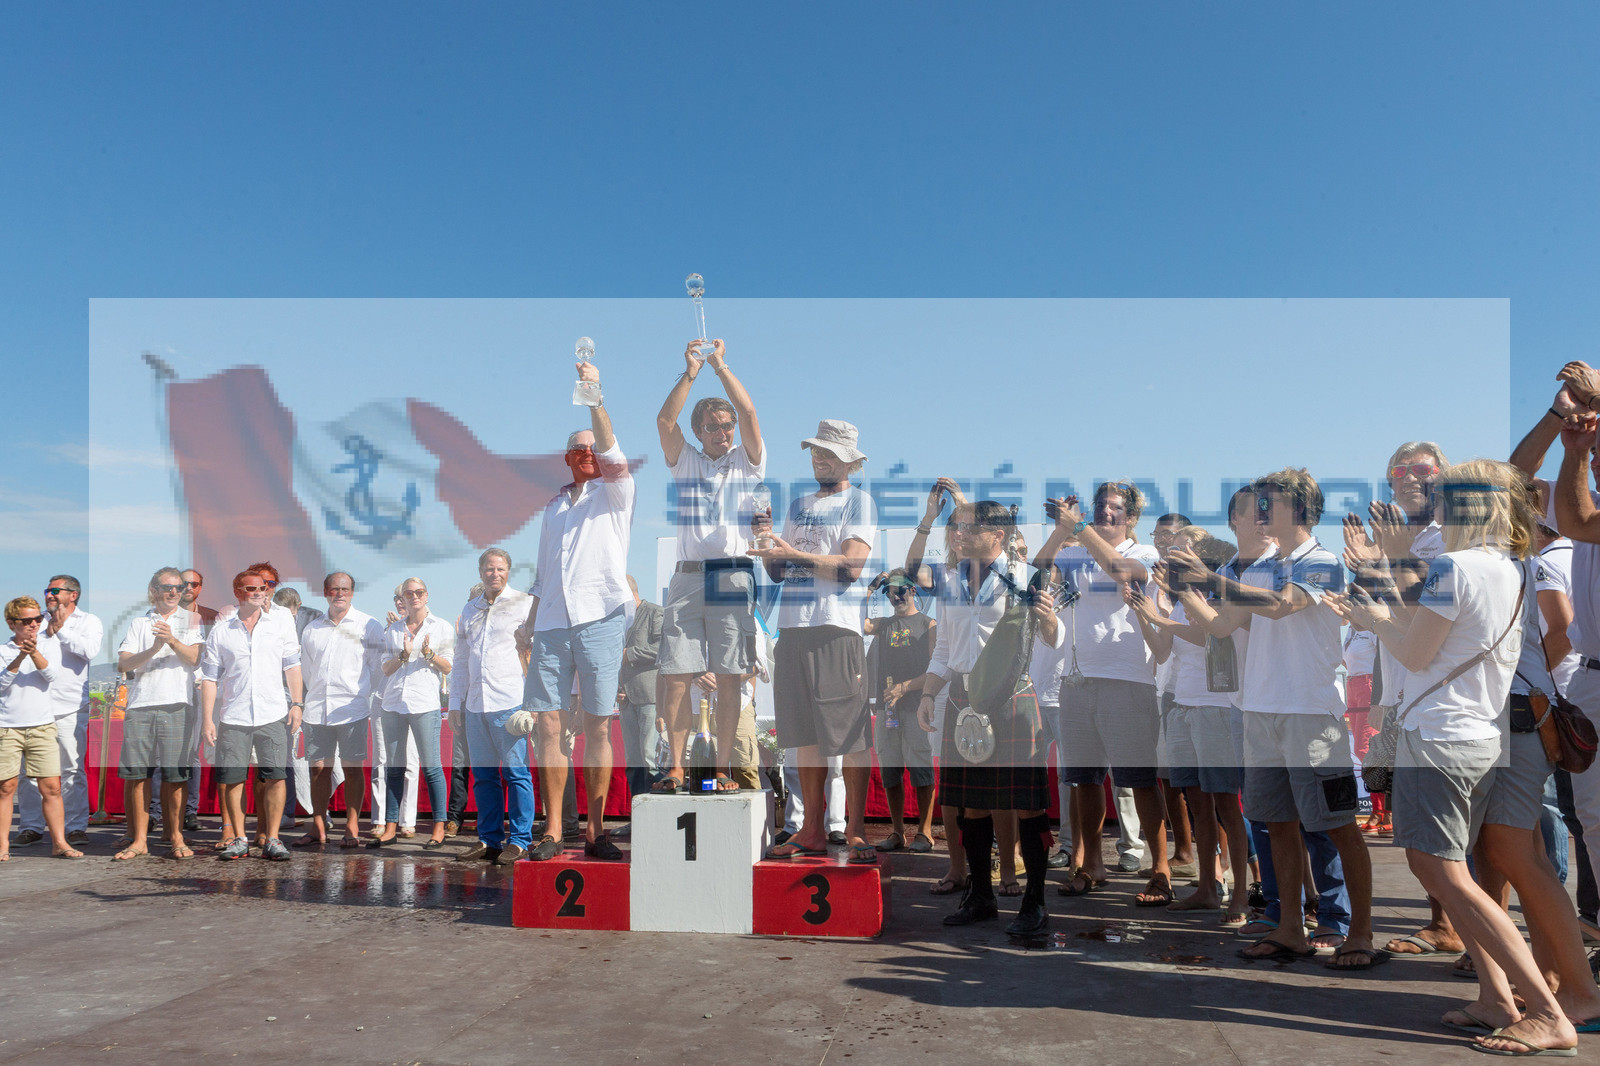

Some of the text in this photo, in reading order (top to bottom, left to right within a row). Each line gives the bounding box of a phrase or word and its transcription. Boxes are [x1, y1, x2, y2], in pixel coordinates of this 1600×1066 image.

[676, 812, 697, 861] 1
[554, 869, 586, 917] 2
[801, 874, 832, 925] 3
